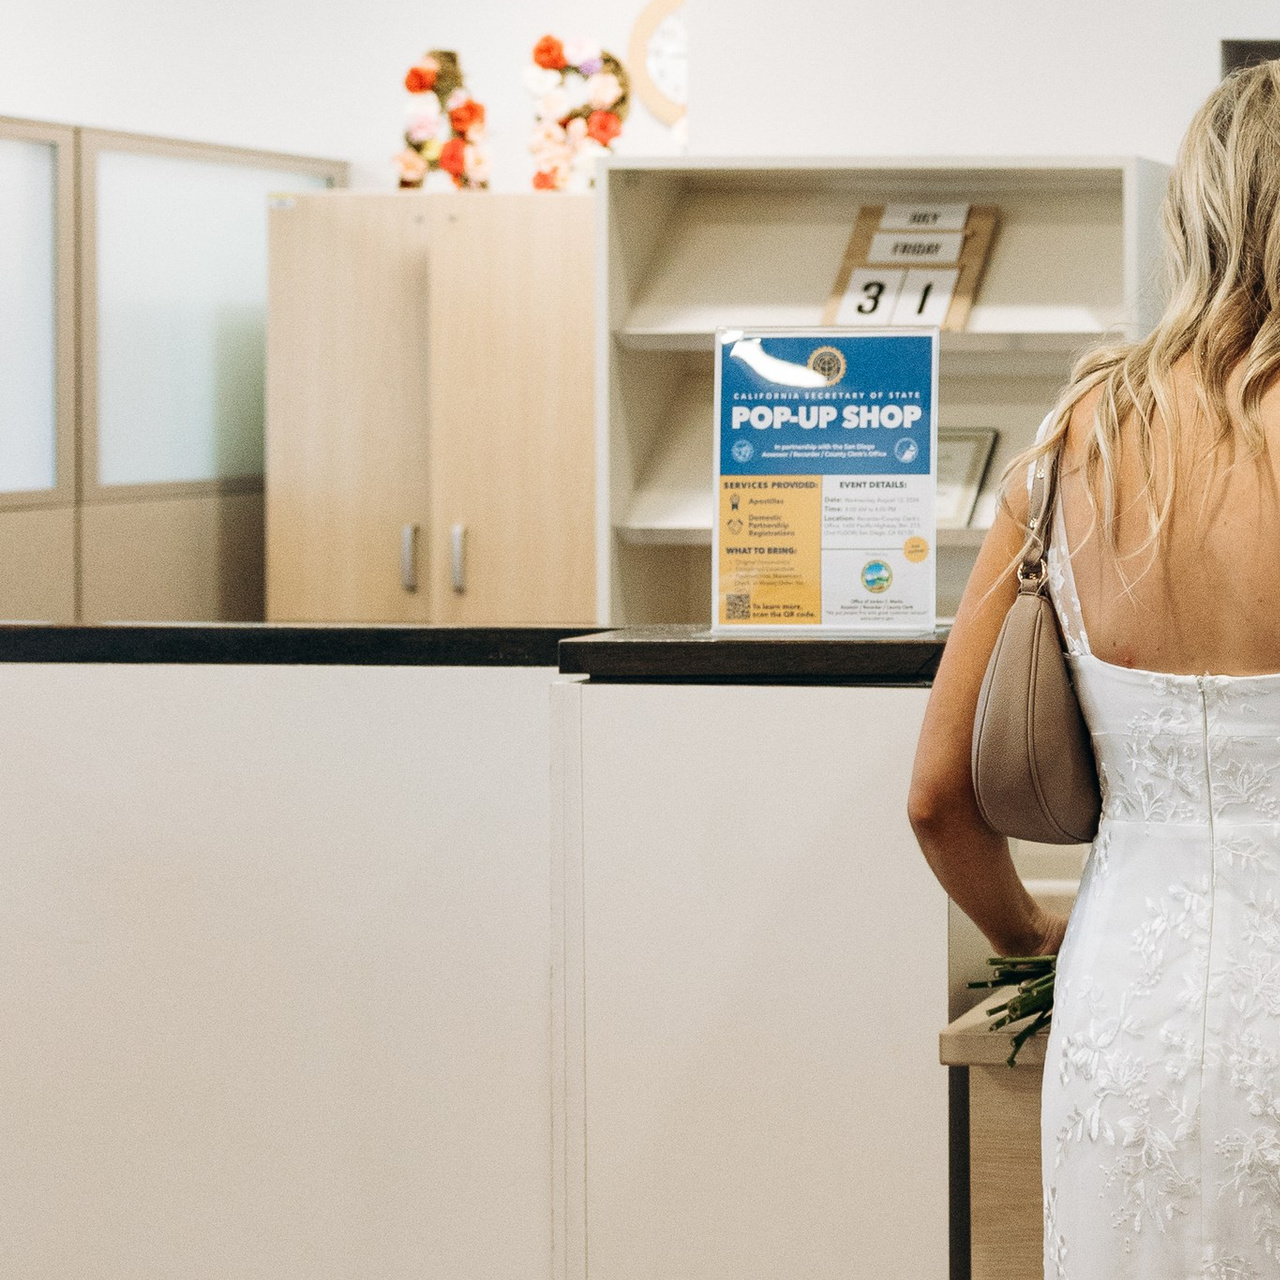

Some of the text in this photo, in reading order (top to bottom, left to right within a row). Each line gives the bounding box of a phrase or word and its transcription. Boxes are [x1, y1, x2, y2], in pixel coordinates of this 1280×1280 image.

[734, 391, 921, 400] CALIFORNIA SECRETARY OF STATE
[731, 404, 922, 430] POP-UP SHOP
[724, 481, 768, 489] SERVICES
[840, 481, 907, 489] EVENT DETAILS:
